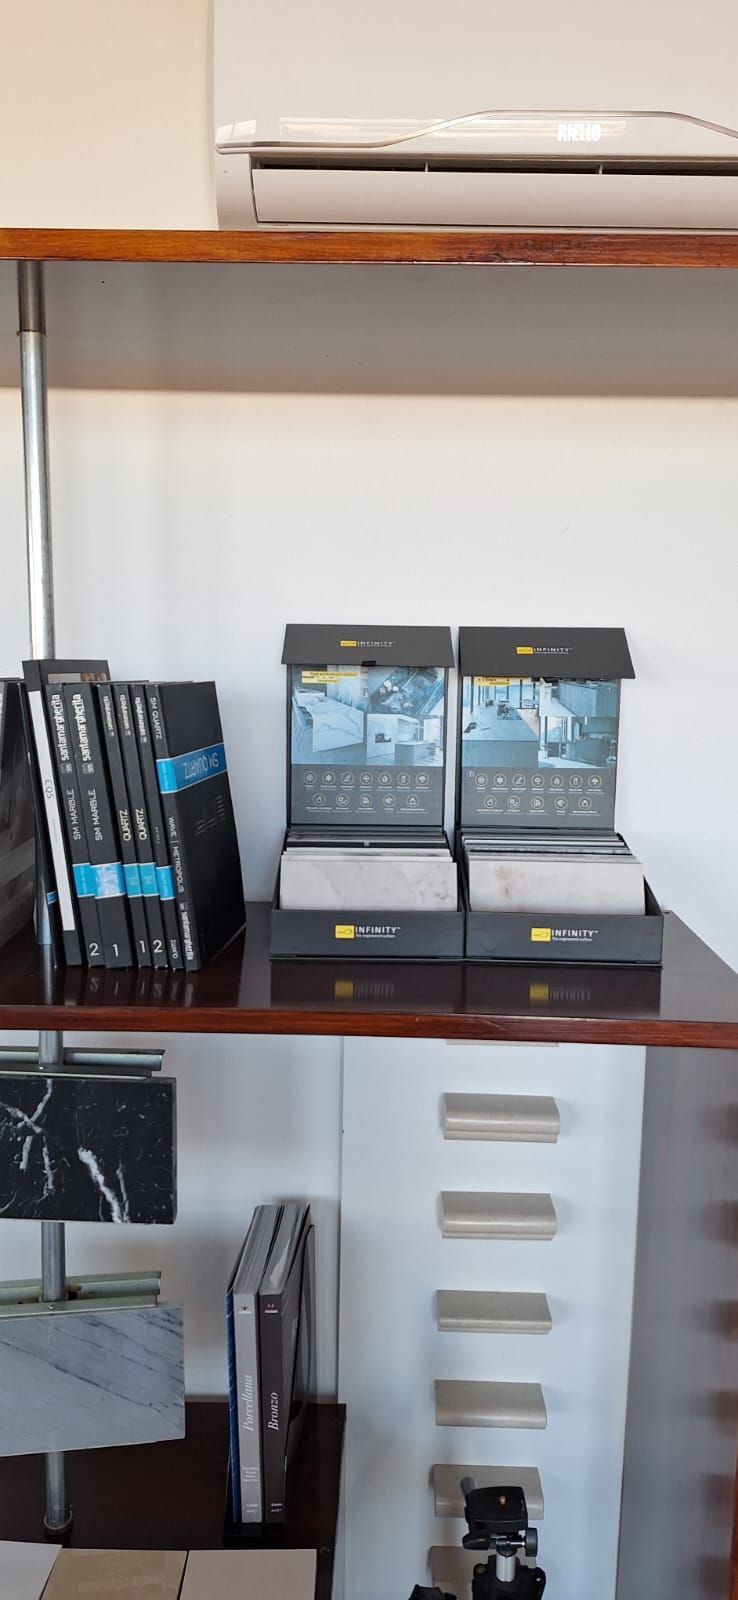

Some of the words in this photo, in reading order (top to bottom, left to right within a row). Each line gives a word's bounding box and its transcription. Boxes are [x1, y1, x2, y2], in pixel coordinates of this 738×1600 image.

[557, 123, 602, 142] RIELLO
[51, 694, 69, 761] santamargherita
[72, 694, 91, 762] santamargherita
[152, 710, 162, 740] QUARTZ
[66, 788, 79, 824] MARBLE
[88, 788, 100, 825] MARBLE
[72, 825, 81, 840] SM
[95, 825, 103, 841] SM
[119, 808, 132, 841] QUARTZ
[135, 808, 148, 841] QUARTZ
[168, 816, 178, 837] WAVE
[171, 846, 185, 893] METROPOLIS
[88, 942, 99, 957] 2
[112, 944, 119, 957] 1
[139, 940, 146, 953] 1
[152, 939, 163, 953] 2
[181, 911, 194, 961] santamargherita
[242, 1374, 254, 1432] Porcellana
[268, 1392, 279, 1431] Bronzo
